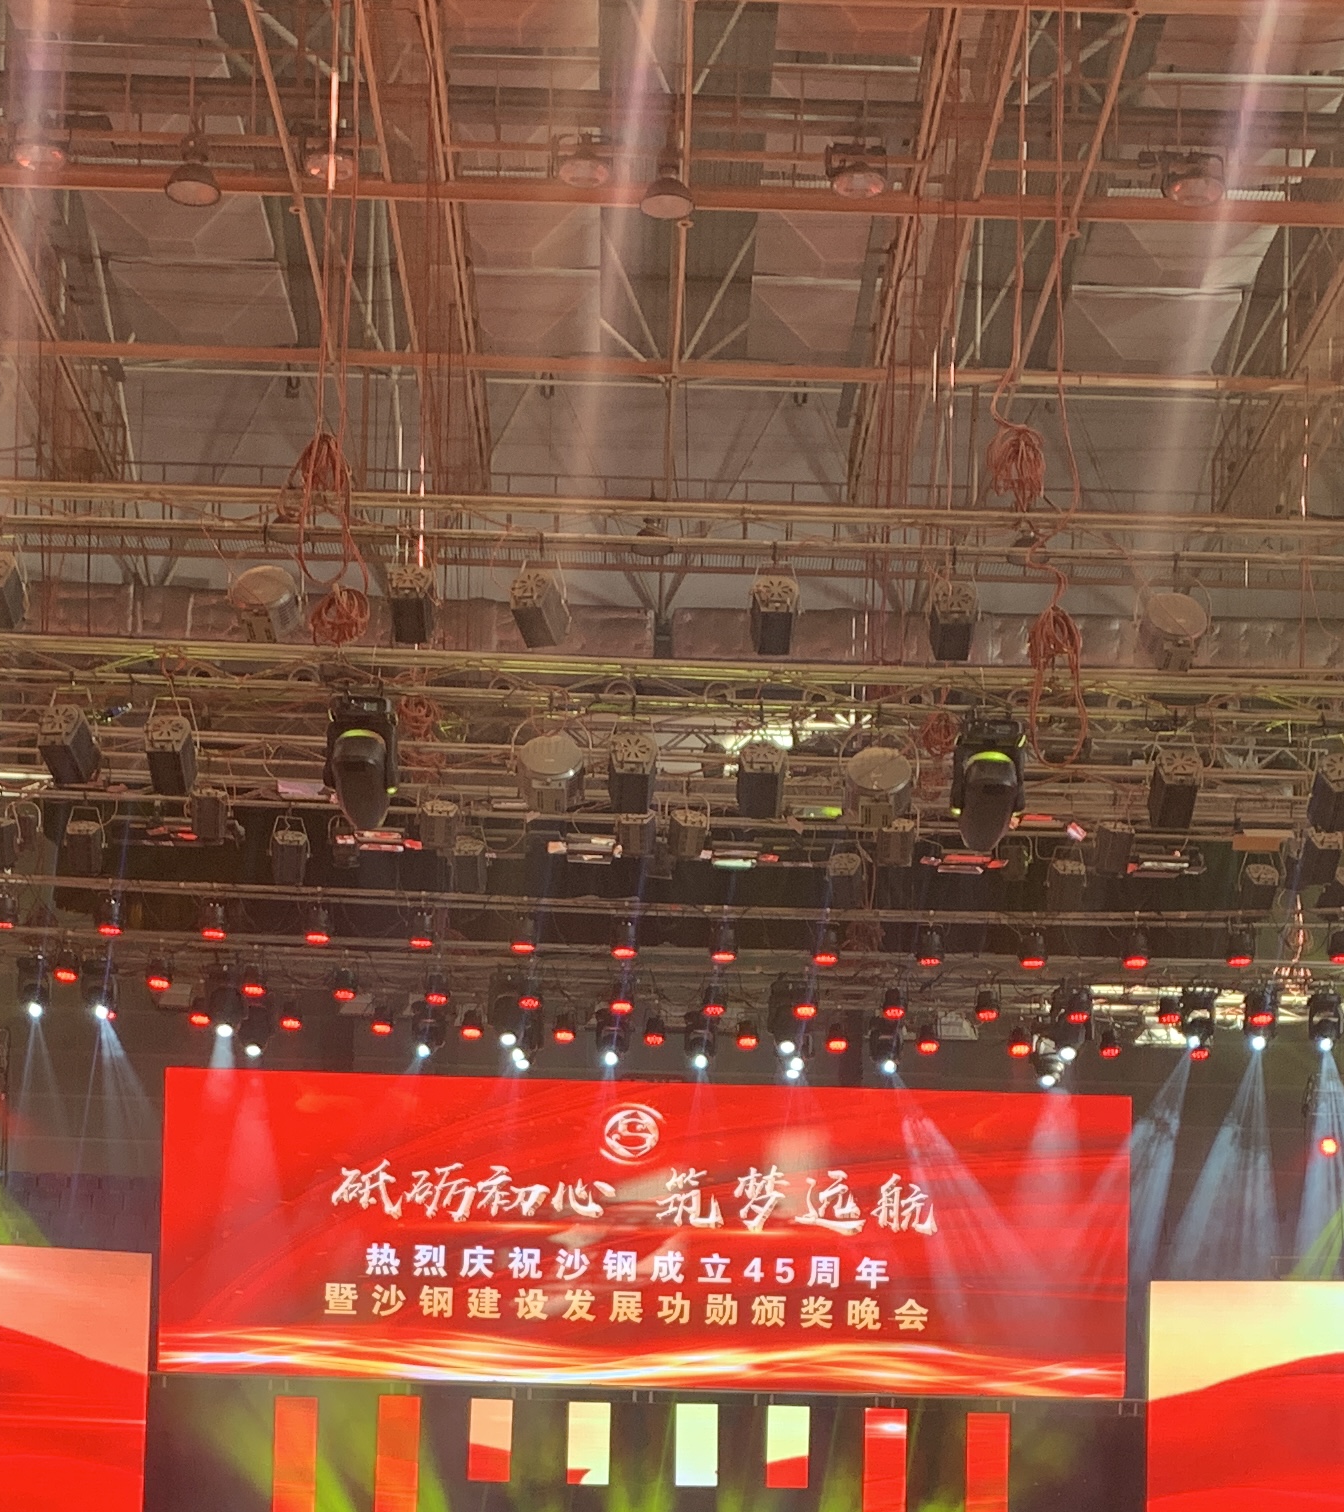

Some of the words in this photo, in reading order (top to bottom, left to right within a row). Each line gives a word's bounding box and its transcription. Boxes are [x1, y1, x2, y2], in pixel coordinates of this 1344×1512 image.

[331, 1158, 616, 1222] 砥砺初心
[655, 1165, 938, 1236] 筑梦远航
[365, 1242, 890, 1289] 热烈庆祝沙钢成立45周年
[324, 1282, 929, 1331] 暨沙钢建设发展功勋颁奖晚会
